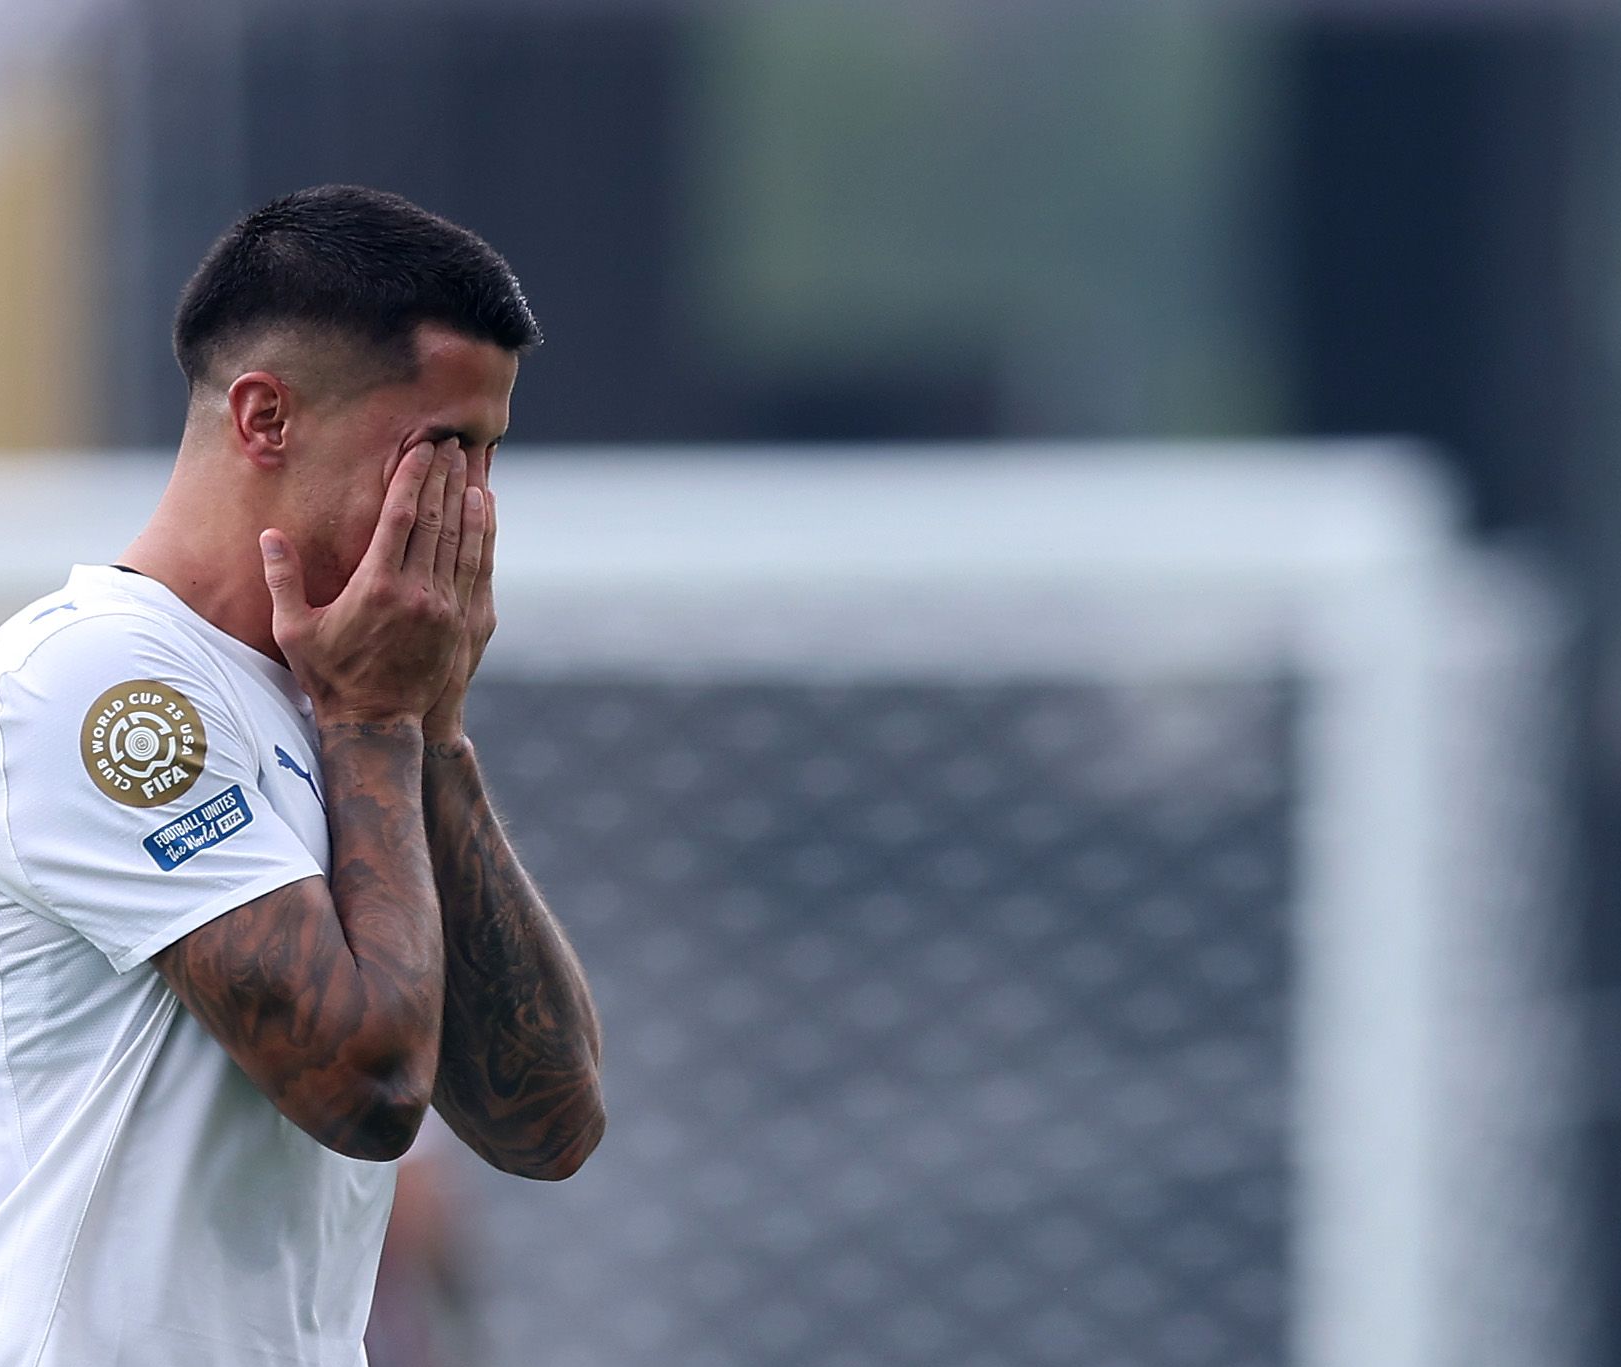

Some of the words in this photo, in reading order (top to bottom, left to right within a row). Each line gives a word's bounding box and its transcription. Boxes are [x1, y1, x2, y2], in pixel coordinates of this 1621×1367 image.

[128, 692, 163, 705] CUP
[164, 702, 184, 720] 25
[91, 699, 124, 754] WORLD
[180, 723, 194, 755] USA
[97, 758, 131, 790] CLUB
[141, 765, 189, 799] FIFA
[153, 813, 204, 849] FOOTBALL
[201, 792, 236, 821] UNITES
[220, 811, 243, 831] FIFA
[165, 844, 187, 862] the
[181, 821, 219, 850] World
